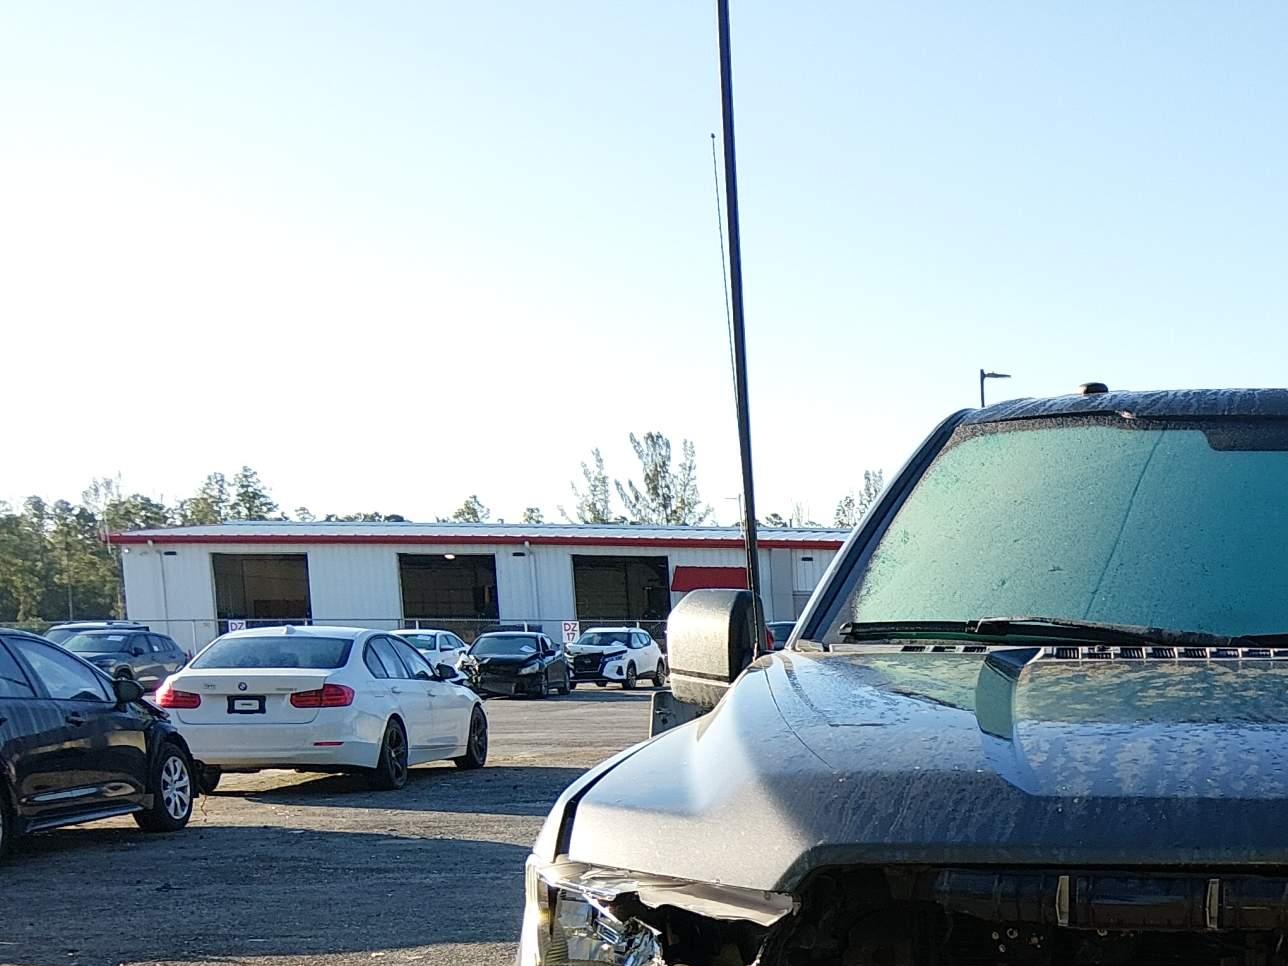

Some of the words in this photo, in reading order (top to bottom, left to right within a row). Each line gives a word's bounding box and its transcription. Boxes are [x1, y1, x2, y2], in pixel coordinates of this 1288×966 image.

[230, 622, 244, 631] DZ
[564, 623, 578, 632] DZ
[566, 633, 576, 641] 17
